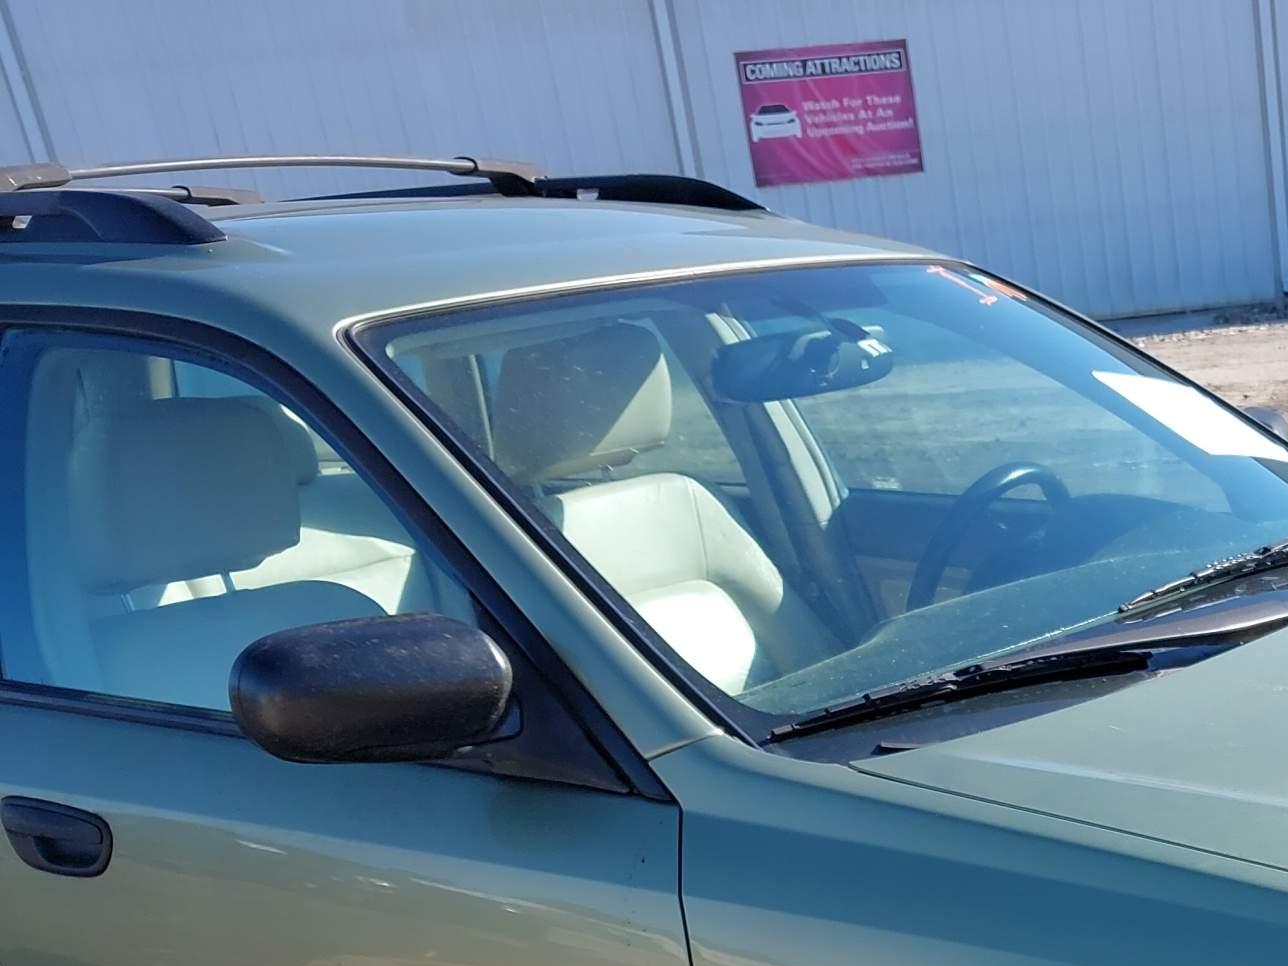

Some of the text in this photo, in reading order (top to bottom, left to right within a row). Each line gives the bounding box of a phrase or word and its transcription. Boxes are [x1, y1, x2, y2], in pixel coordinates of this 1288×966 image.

[745, 52, 901, 80] COMING ATTRACTIONS
[802, 95, 901, 111] Watch For These
